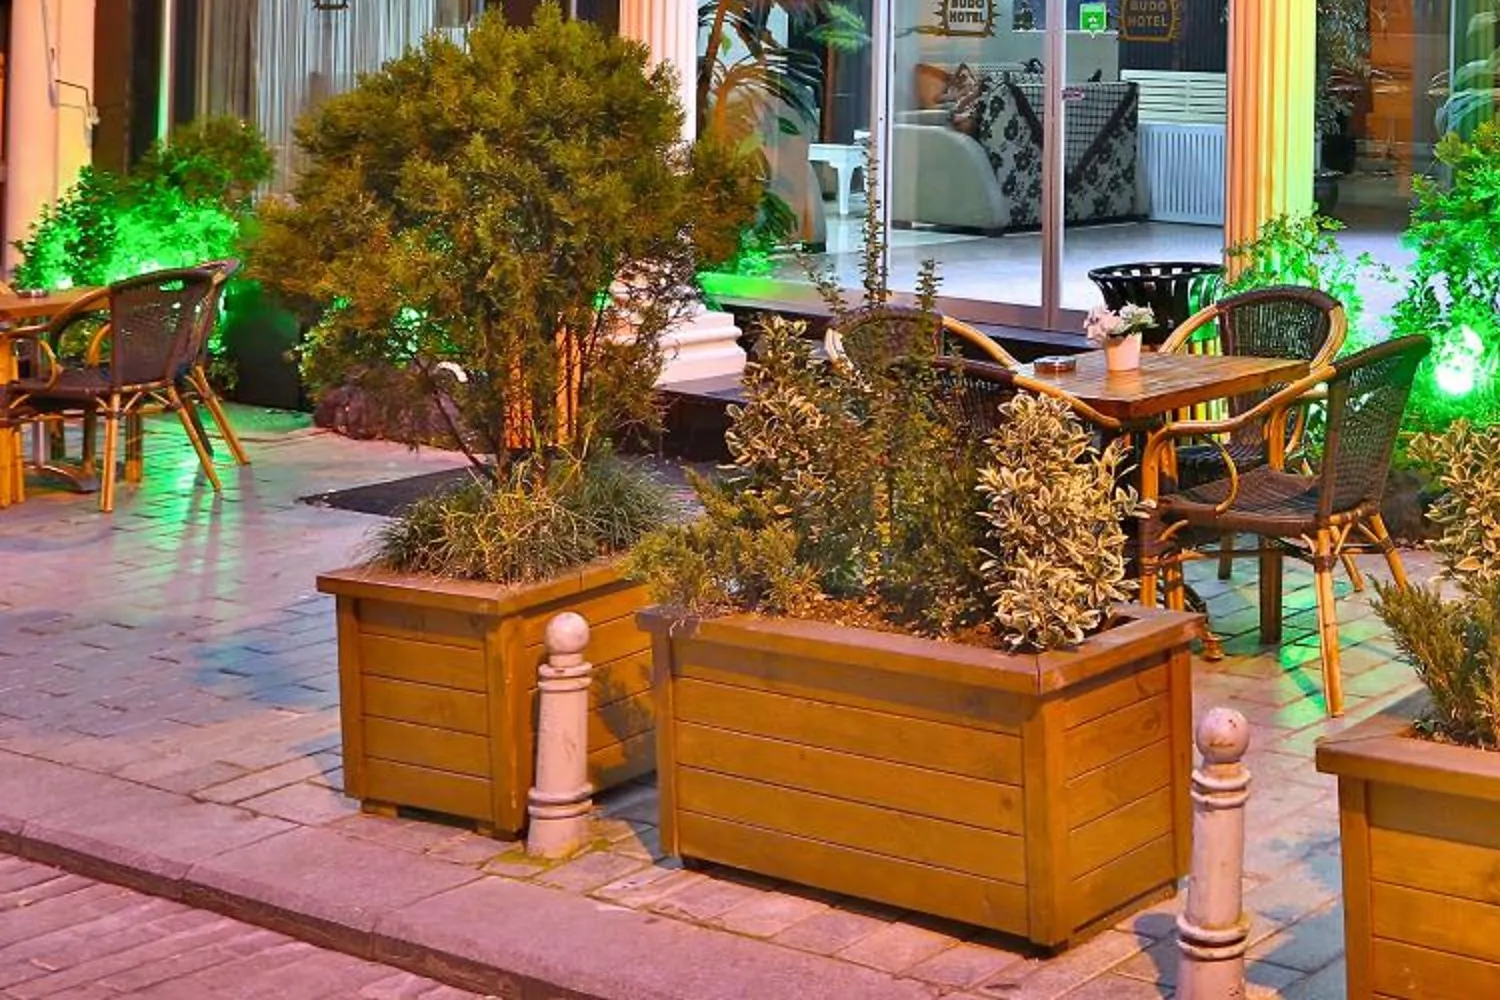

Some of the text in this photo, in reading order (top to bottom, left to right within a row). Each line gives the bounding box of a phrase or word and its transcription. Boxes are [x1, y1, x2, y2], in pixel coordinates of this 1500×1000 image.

[1129, 0, 1168, 12] BUDO
[949, 10, 985, 23] HOTEL
[1127, 14, 1168, 27] HOTEL
